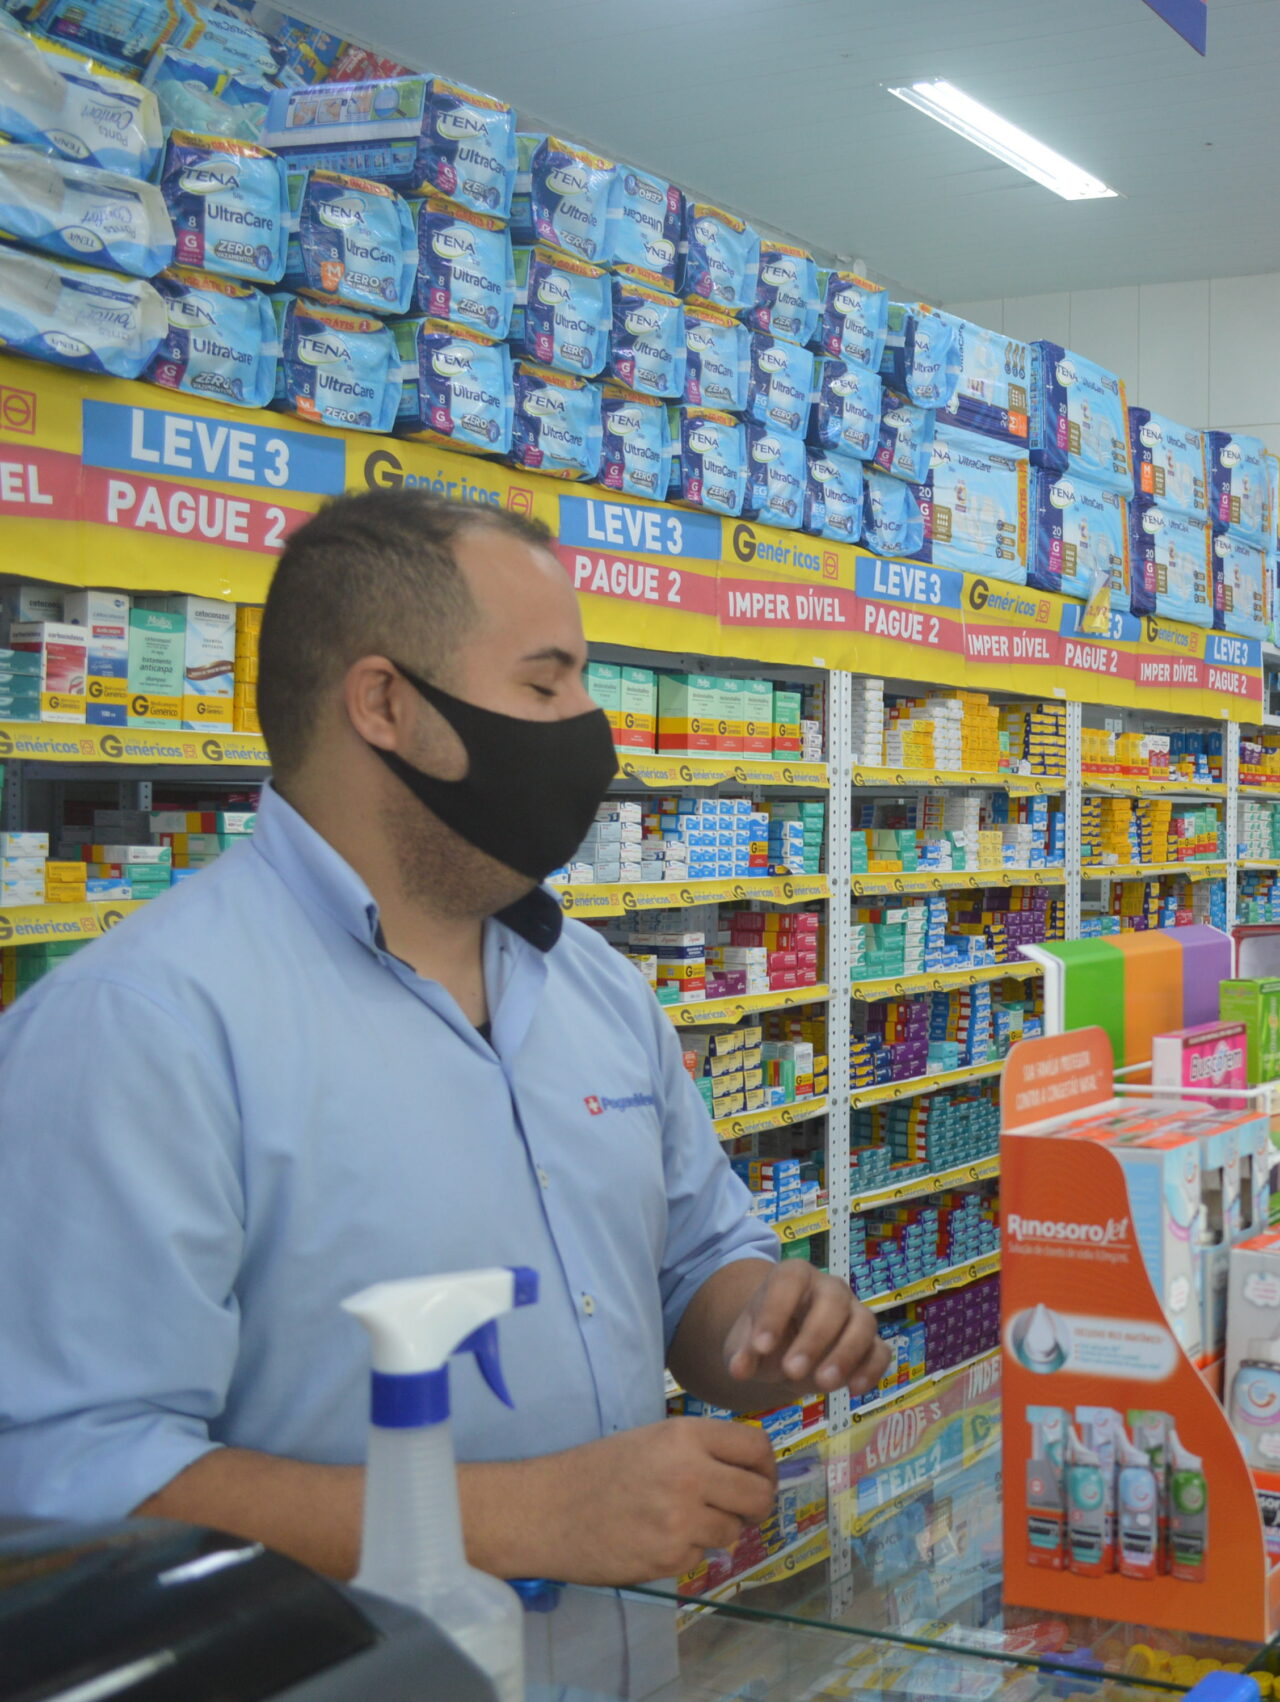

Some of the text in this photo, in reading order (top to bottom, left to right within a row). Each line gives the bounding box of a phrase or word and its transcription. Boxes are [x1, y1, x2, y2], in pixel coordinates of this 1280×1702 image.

[437, 110, 489, 135] TENA
[53, 135, 81, 153] TENA
[183, 166, 241, 188] TENA
[552, 167, 590, 192] TENA
[638, 188, 663, 203] ZERO
[207, 203, 274, 231] UltraCare
[320, 202, 365, 224] TENA
[623, 205, 663, 232] UltraCare
[70, 231, 95, 248] TENA
[185, 234, 197, 248] G
[218, 240, 254, 256] ZERO
[432, 231, 476, 255] TENA
[643, 242, 675, 264] TENA
[327, 265, 341, 277] M
[346, 271, 380, 288] ZERO
[452, 266, 502, 295] UltraCare
[764, 264, 798, 281] TENA
[540, 279, 571, 300] TENA
[460, 299, 485, 315] ZERO
[835, 293, 863, 311] TENA
[625, 312, 661, 331] TENA
[845, 317, 875, 338] UltraCare
[686, 331, 715, 348] TENA
[299, 338, 351, 361] TENA
[562, 343, 584, 361] ZERO
[635, 339, 673, 364] UltraCare
[432, 350, 472, 370] TENA
[760, 352, 788, 370] TENA
[163, 364, 177, 377] G
[1056, 363, 1079, 382] TENA
[318, 375, 374, 399] UltraCare
[771, 380, 805, 401] UltraCare
[453, 386, 501, 409] UltraCare
[526, 392, 565, 412] TENA
[325, 407, 356, 422] ZERO
[435, 410, 447, 423] G
[771, 407, 791, 420] ZERO
[1059, 404, 1067, 415] 20
[462, 414, 488, 430] ZERO
[608, 413, 641, 431] TENA
[542, 423, 583, 447] UltraCare
[690, 430, 719, 449] TENA
[1141, 426, 1163, 441] TENA
[131, 408, 290, 487] LEVE 3
[623, 443, 661, 464] UltraCare
[753, 442, 782, 457] TENA
[1143, 451, 1152, 462] 20
[1220, 447, 1242, 462] TENA
[703, 459, 738, 480] UltraCare
[811, 461, 842, 479] TENA
[958, 454, 992, 473] UltraCare
[633, 469, 653, 483] ZERO
[709, 485, 730, 500] ZERO
[754, 485, 768, 496] EG
[825, 487, 858, 505] UltraCare
[919, 486, 932, 498] 20
[1051, 485, 1076, 503] TENA
[1222, 482, 1231, 492] 20
[107, 479, 288, 549] PAGUE 2
[1019, 487, 1028, 544] GRÁTIS
[1143, 514, 1166, 529] TENA
[586, 500, 683, 556] LEVE 3
[1052, 525, 1062, 537] 20
[1145, 548, 1155, 559] 20
[1214, 537, 1232, 551] TENA
[574, 554, 681, 603] PAGUE 2
[873, 560, 942, 604] LEVE 3
[728, 588, 846, 622] IMPER DÍVEL
[864, 605, 940, 644] PAGUE 2
[1113, 614, 1124, 641] 3
[967, 630, 1050, 659] IMPER DÍVEL
[1213, 639, 1249, 666] LEVE 3
[1064, 642, 1119, 673] PAGUE 2
[140, 662, 173, 673] anticaspa
[1140, 659, 1199, 683] IMPER DÍVEL
[88, 681, 104, 698] G
[1208, 668, 1248, 694] PAGUE 2
[132, 695, 150, 716] G
[100, 735, 183, 759] Genéricos
